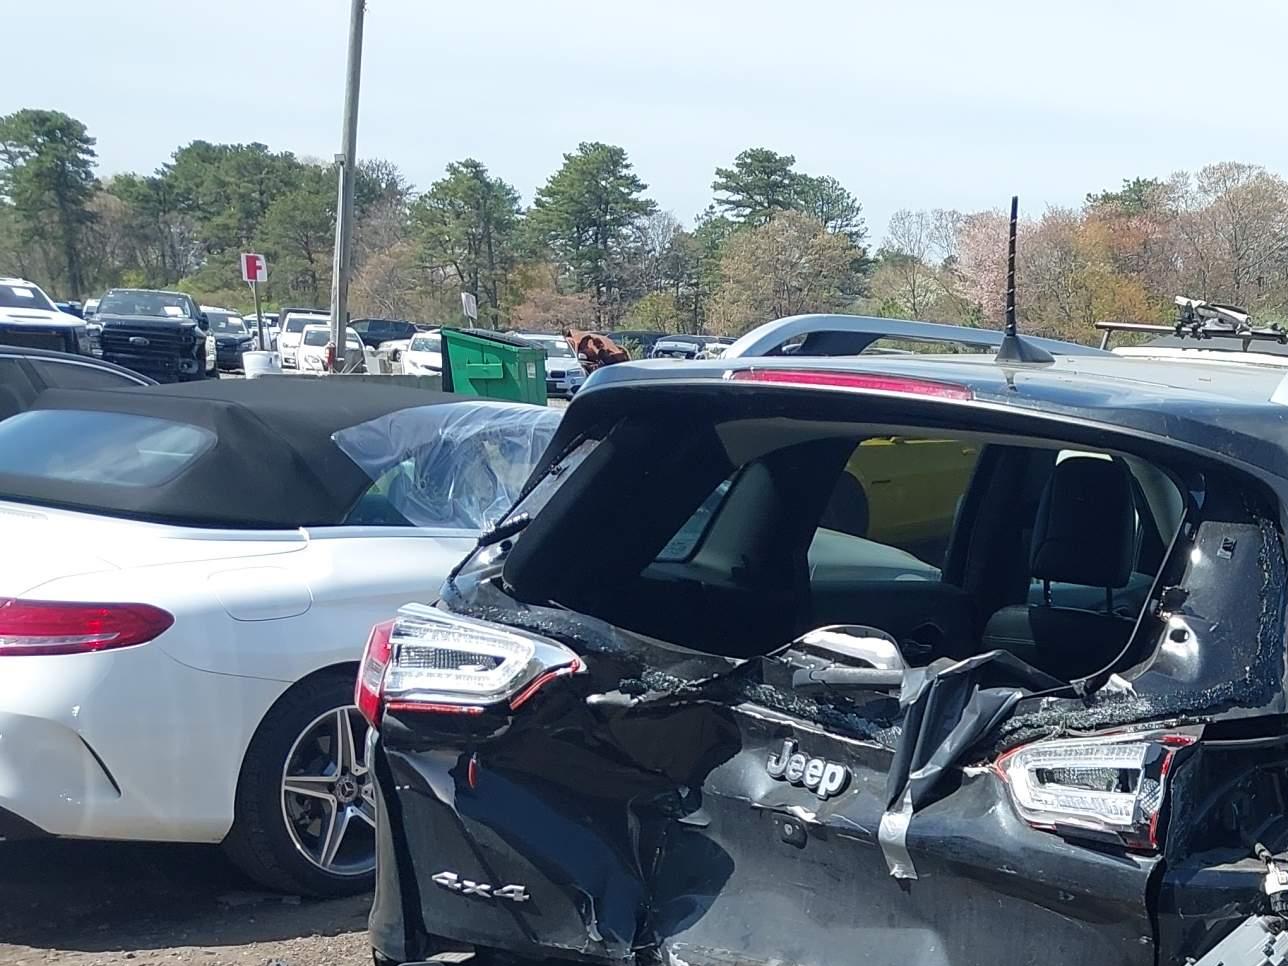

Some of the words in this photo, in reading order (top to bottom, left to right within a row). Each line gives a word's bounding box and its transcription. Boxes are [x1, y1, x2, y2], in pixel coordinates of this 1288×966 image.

[245, 255, 263, 280] F
[766, 738, 849, 799] Jeep
[431, 871, 530, 902] 4x4
